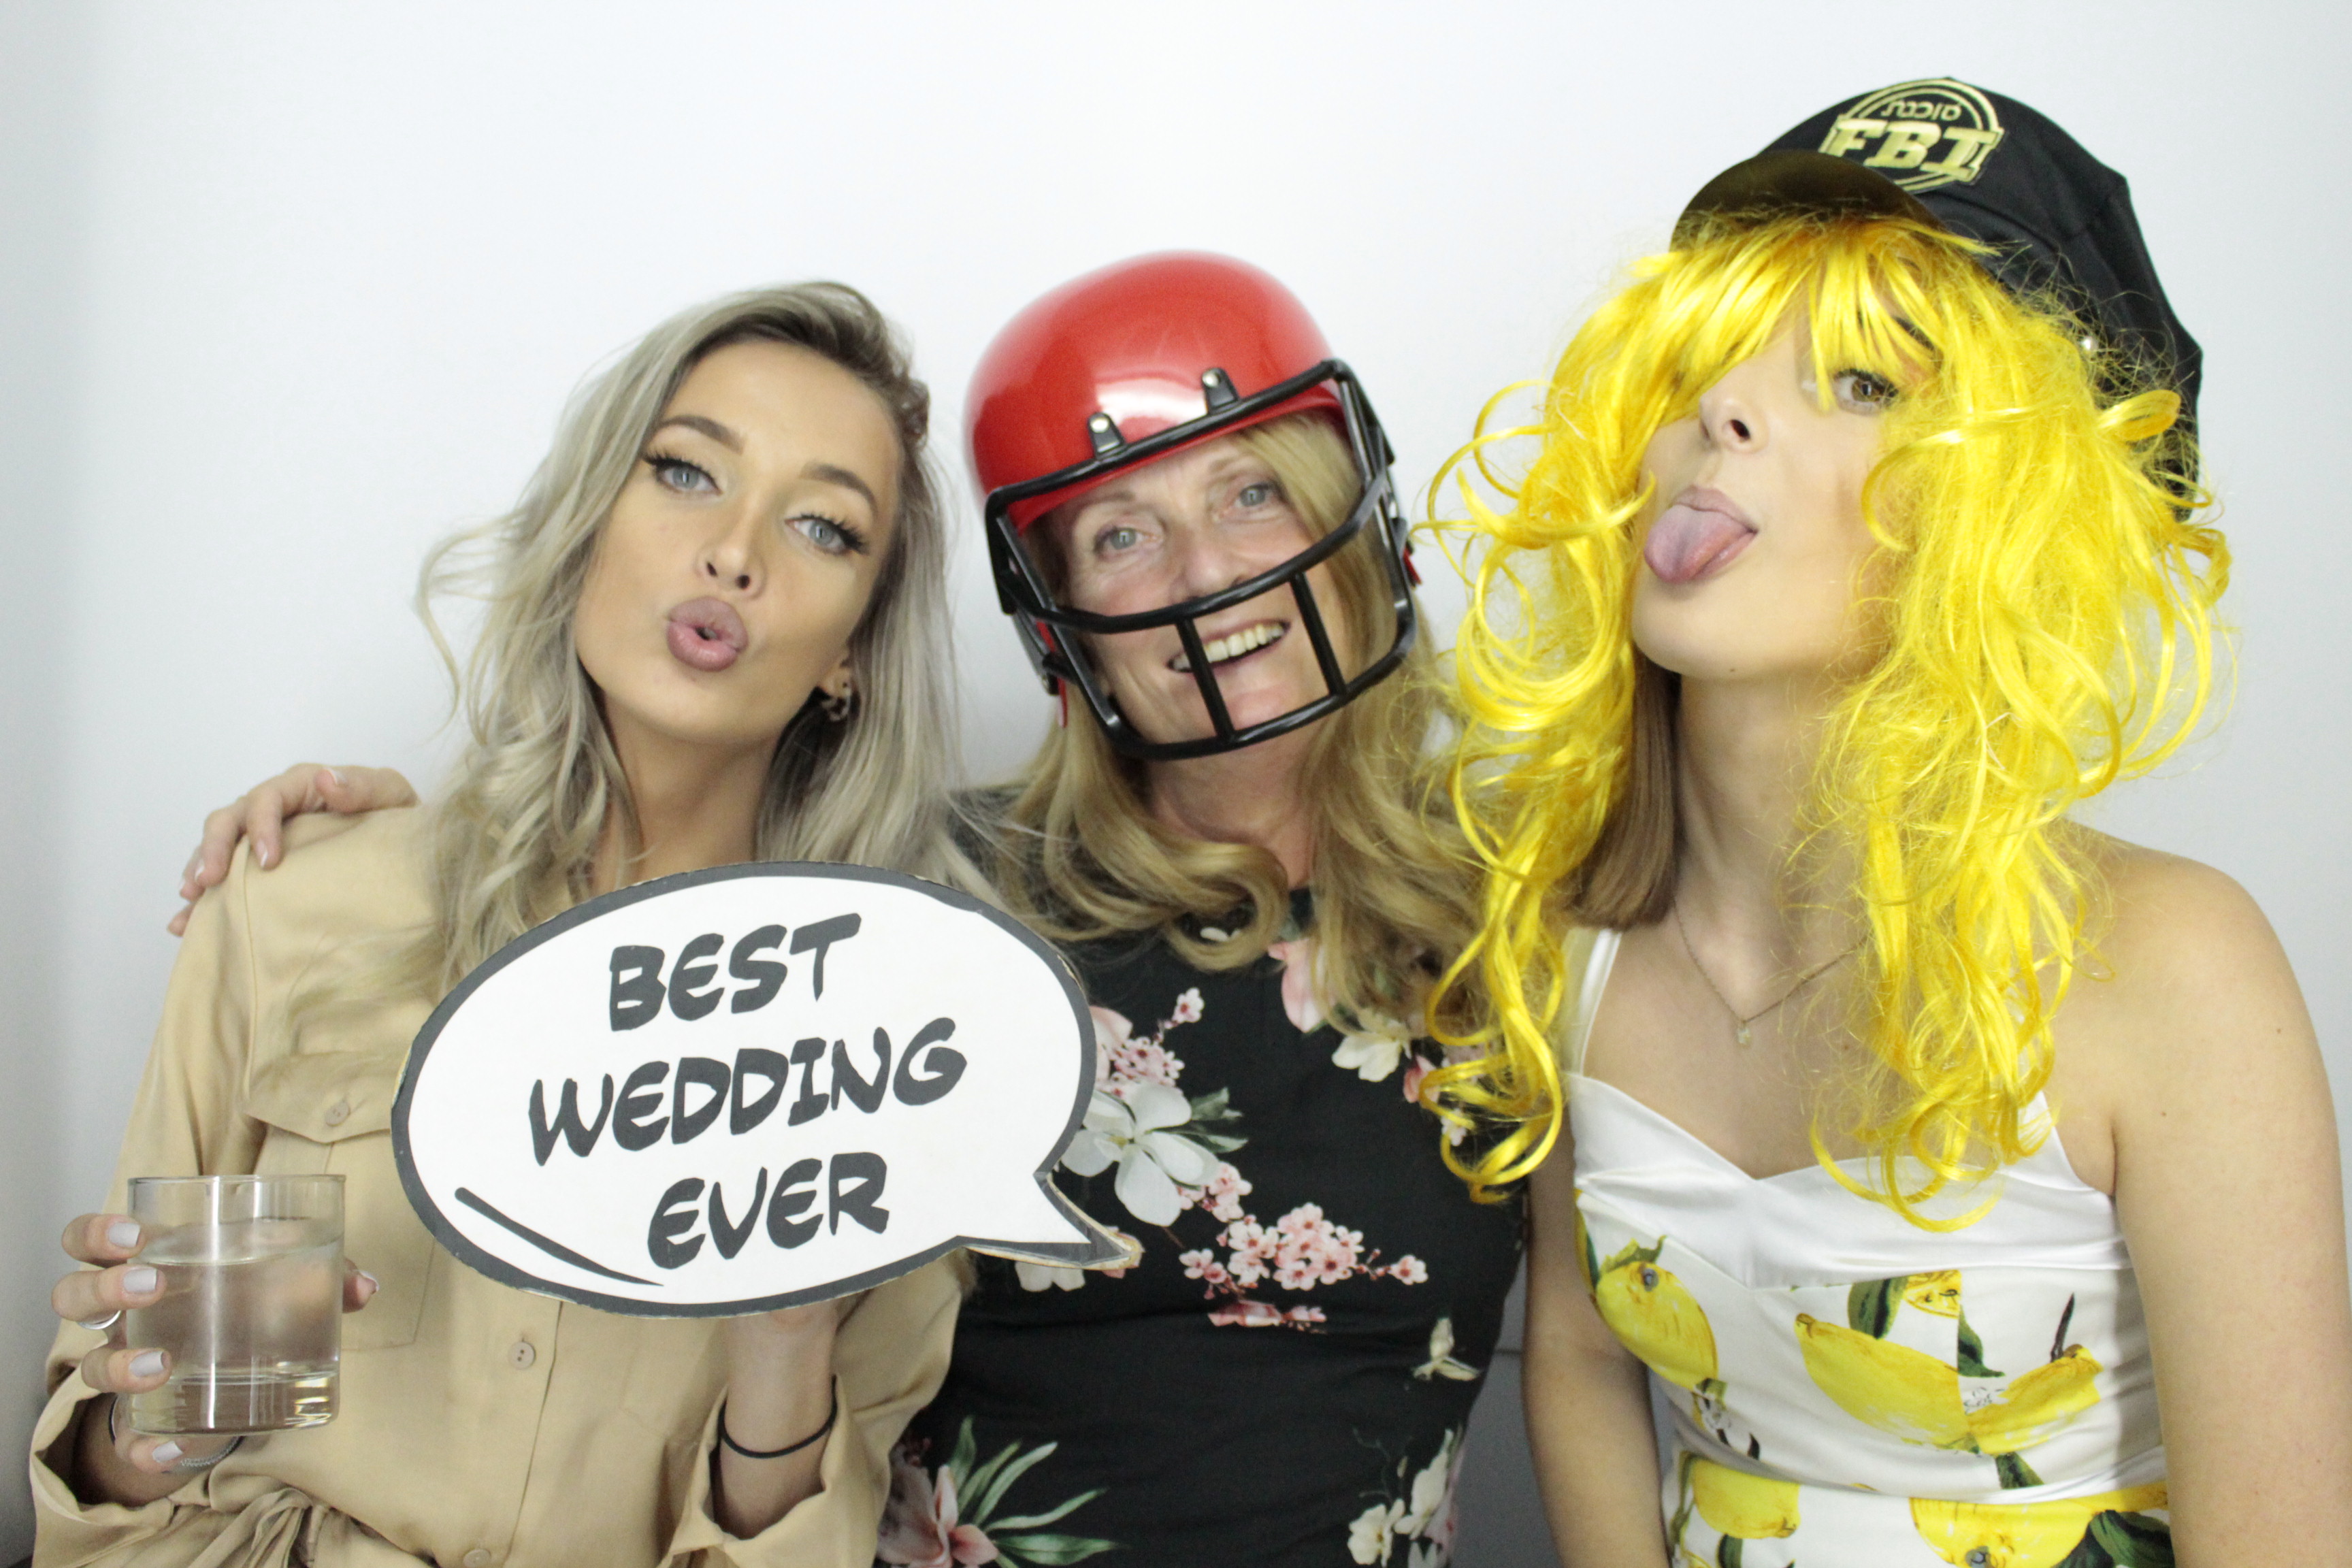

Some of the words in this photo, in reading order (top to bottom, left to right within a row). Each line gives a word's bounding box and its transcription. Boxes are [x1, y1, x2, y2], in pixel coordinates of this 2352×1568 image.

[1825, 118, 1999, 180] FBI
[610, 913, 861, 1031] BEST
[529, 1018, 966, 1166] WEDDING
[648, 1152, 889, 1269] EVER
